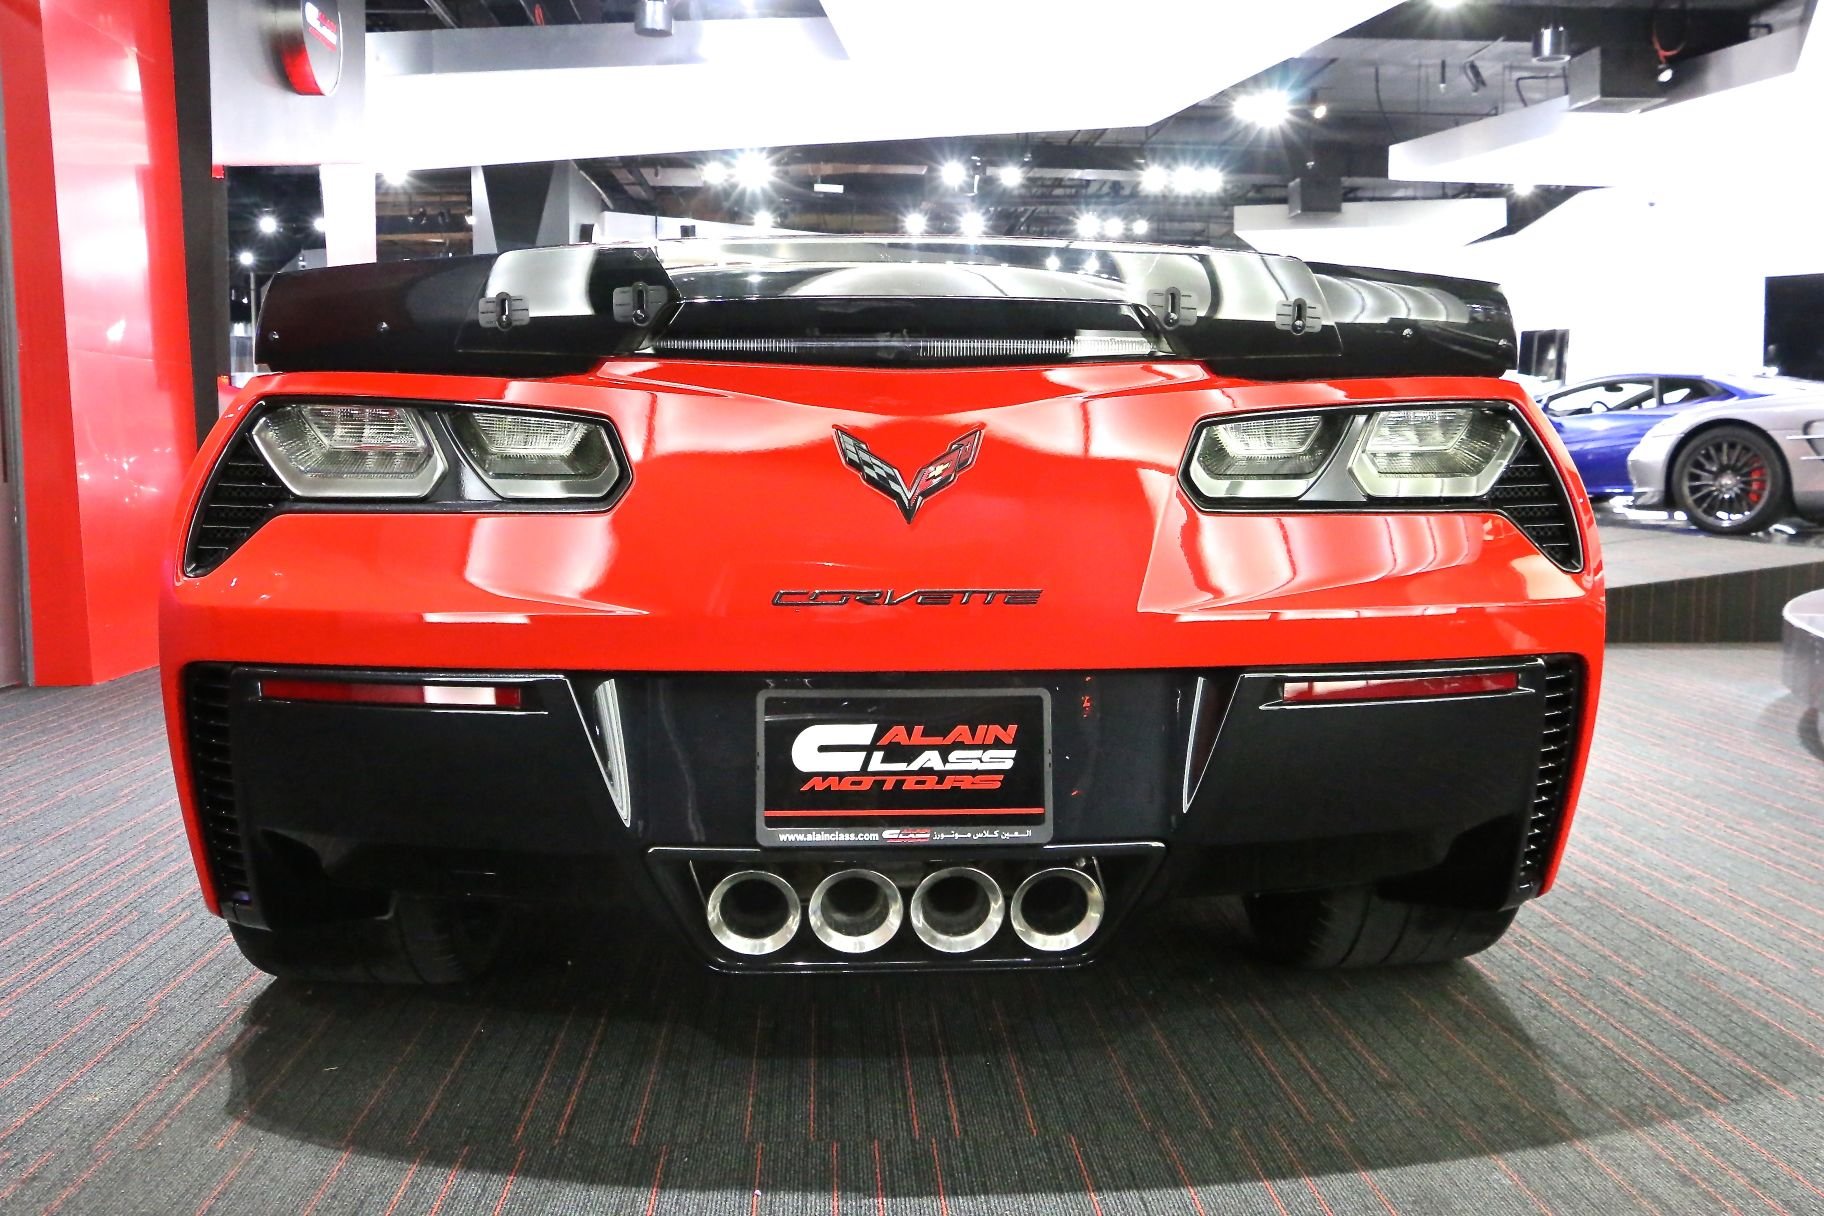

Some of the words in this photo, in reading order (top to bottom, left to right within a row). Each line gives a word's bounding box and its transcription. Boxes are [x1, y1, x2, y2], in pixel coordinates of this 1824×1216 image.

[772, 589, 1043, 606] CORVETTE
[876, 724, 1018, 746] ALAIN
[791, 723, 1017, 773] CLASS
[800, 774, 1004, 791] MOTORS
[778, 832, 879, 842] www.alainclass.com
